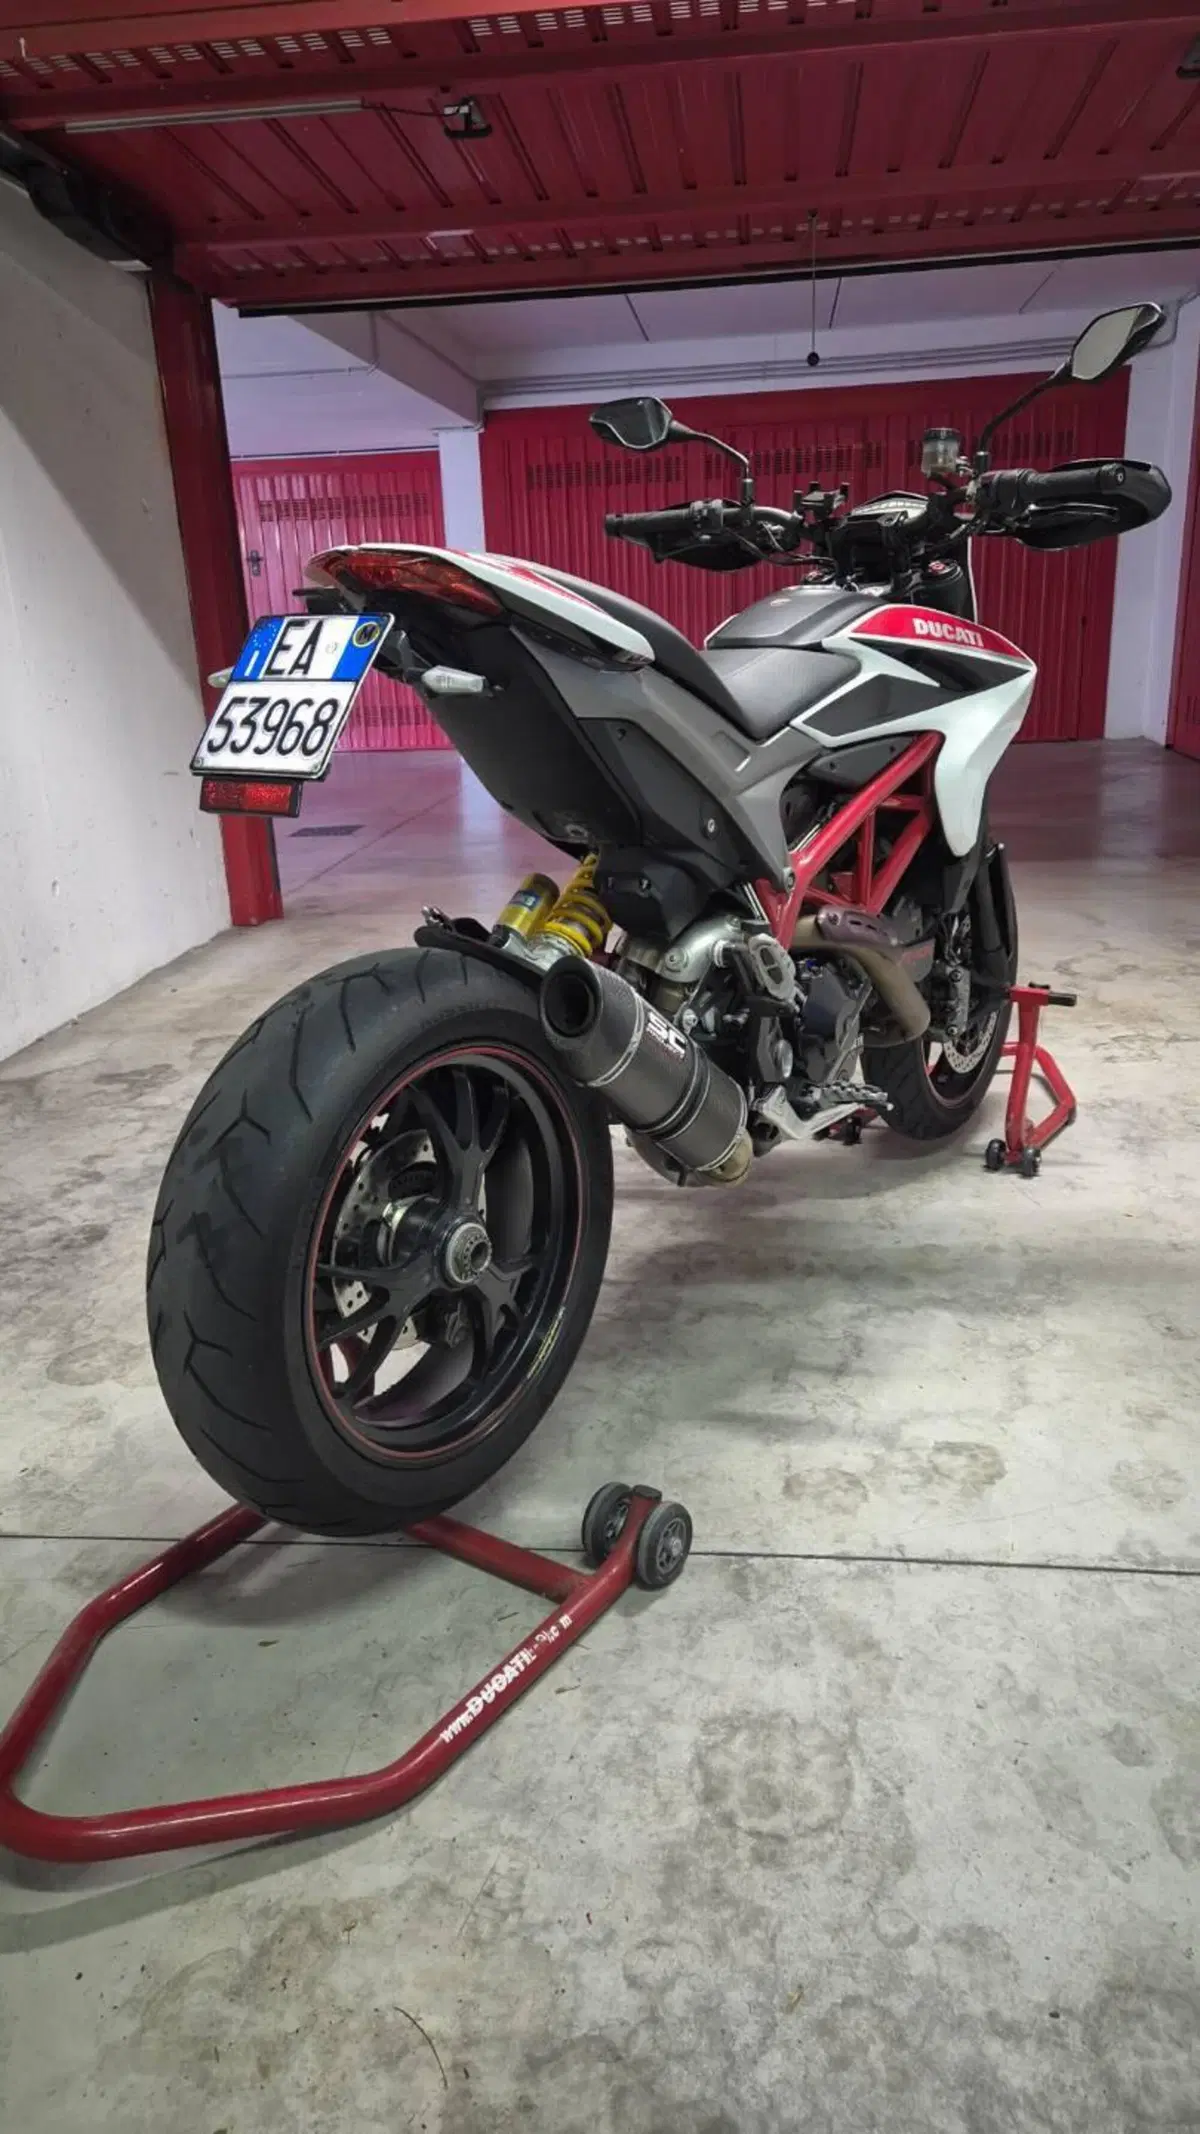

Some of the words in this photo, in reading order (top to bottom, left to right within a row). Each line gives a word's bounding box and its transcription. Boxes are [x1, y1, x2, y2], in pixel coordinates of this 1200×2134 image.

[265, 618, 324, 676] EA
[912, 617, 985, 648] DUCATI
[207, 697, 339, 757] 53968
